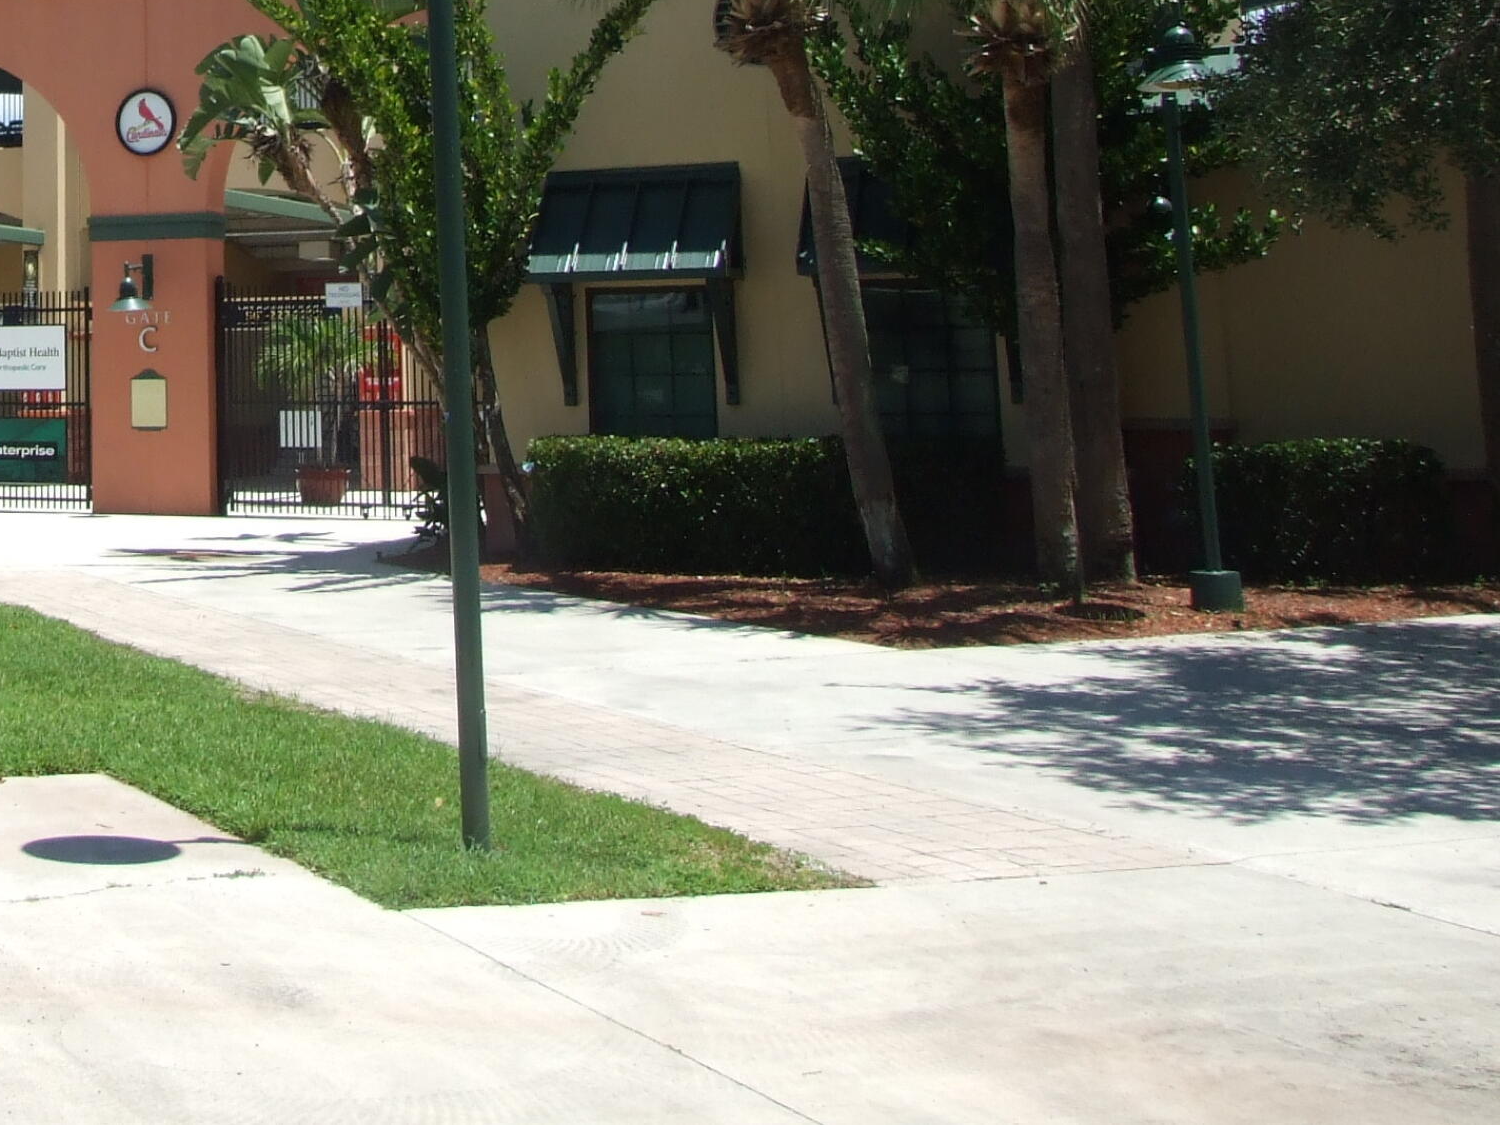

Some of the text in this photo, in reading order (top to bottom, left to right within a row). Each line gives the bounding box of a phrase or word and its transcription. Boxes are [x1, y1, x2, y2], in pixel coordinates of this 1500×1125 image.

[126, 311, 172, 324] GATE
[138, 325, 159, 353] C
[29, 346, 60, 357] Health
